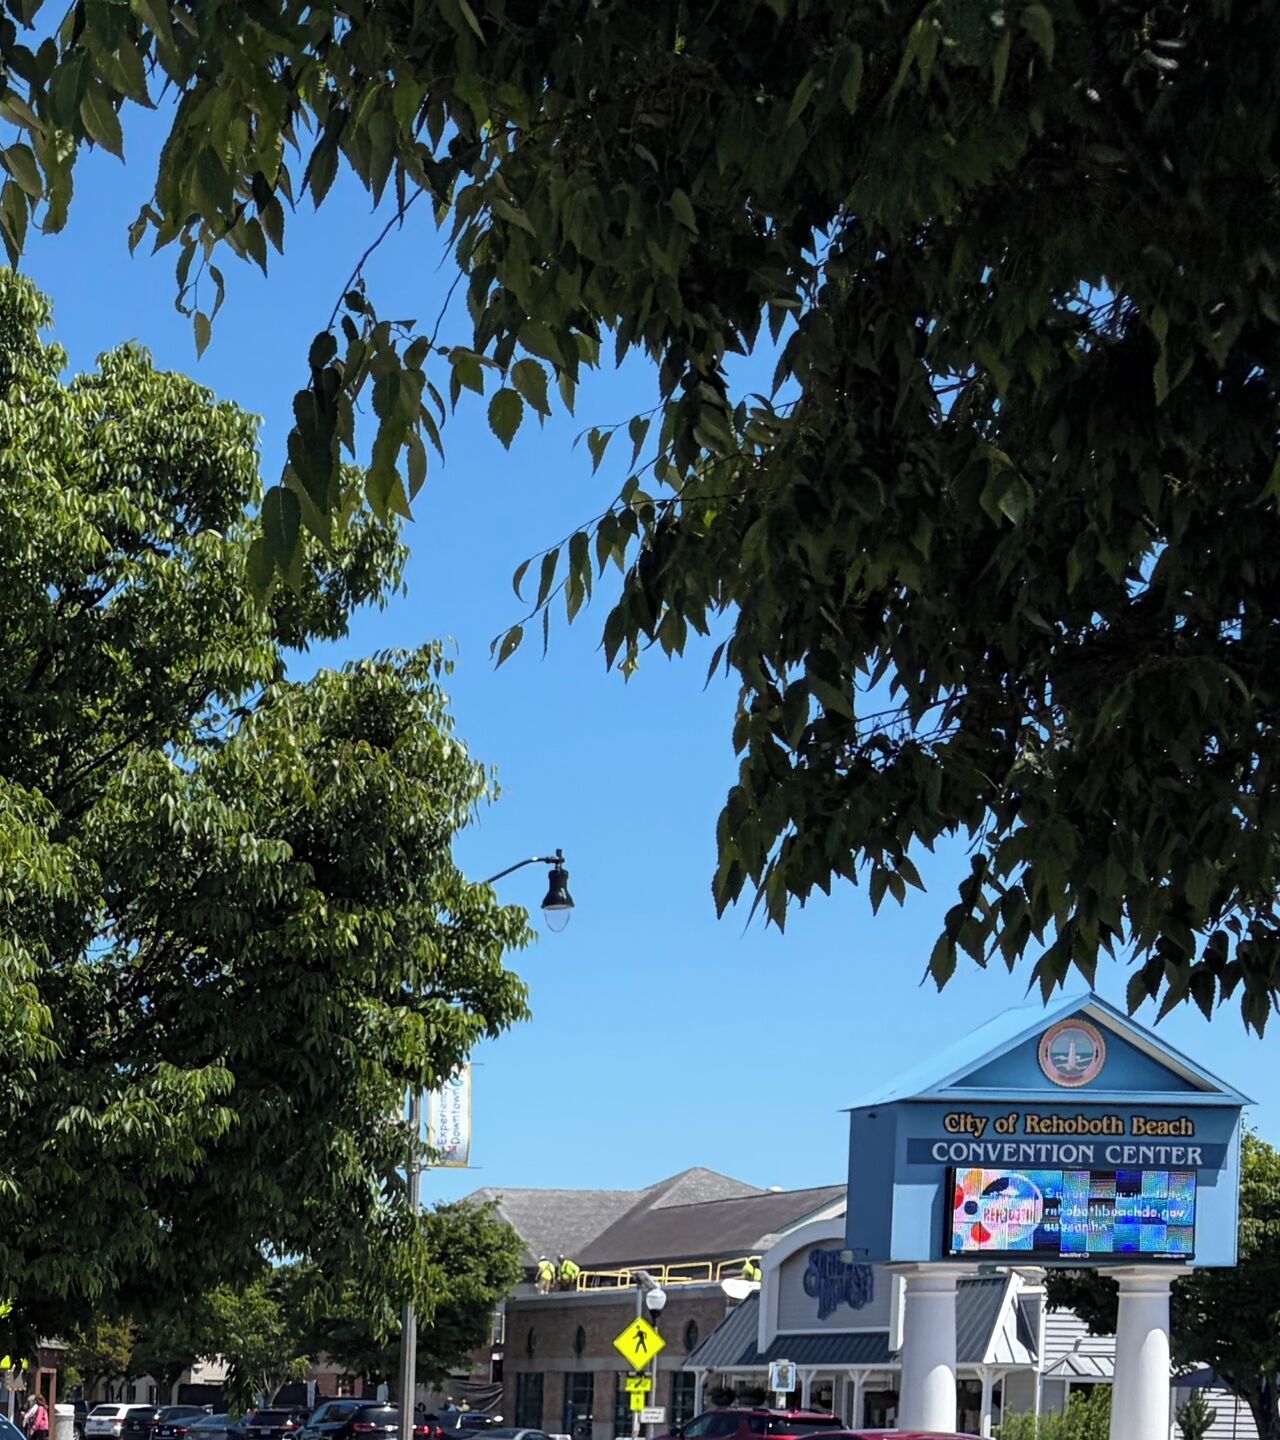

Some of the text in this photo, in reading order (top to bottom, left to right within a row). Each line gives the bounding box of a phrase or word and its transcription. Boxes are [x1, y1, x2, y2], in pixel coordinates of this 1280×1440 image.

[945, 1113, 1193, 1138] City of Rehoboth Beach
[932, 1142, 1203, 1165] CONVENTION CENTER
